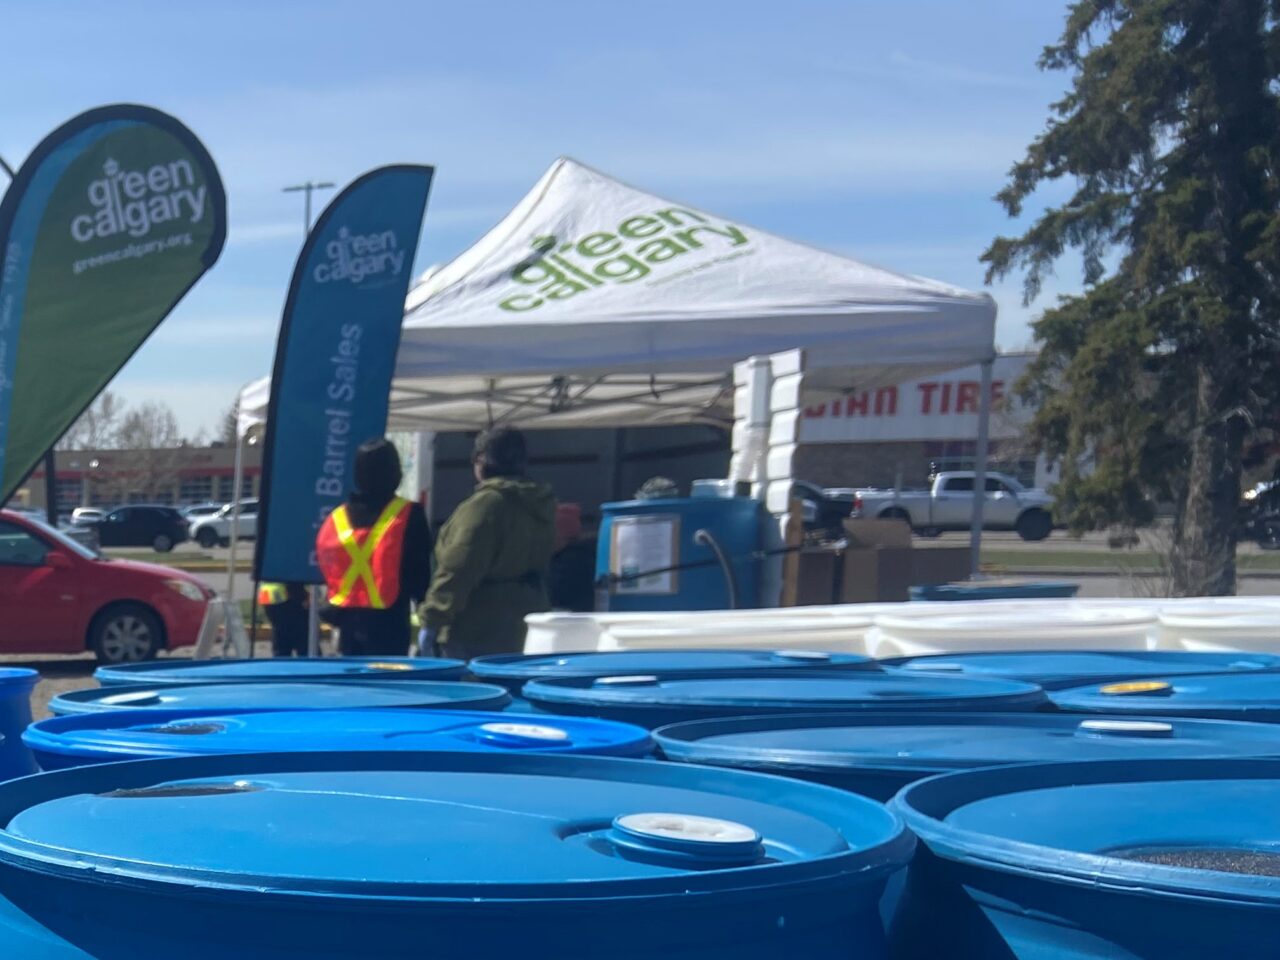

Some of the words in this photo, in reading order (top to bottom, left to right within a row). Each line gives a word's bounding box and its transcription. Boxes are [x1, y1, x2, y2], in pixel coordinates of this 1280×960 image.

[71, 185, 207, 243] calgary
[87, 158, 195, 212] green
[313, 248, 405, 285] calgary
[327, 228, 398, 264] green
[498, 223, 750, 312] calgary
[511, 207, 710, 290] green
[327, 323, 363, 403] Sales
[315, 408, 351, 497] Barrel
